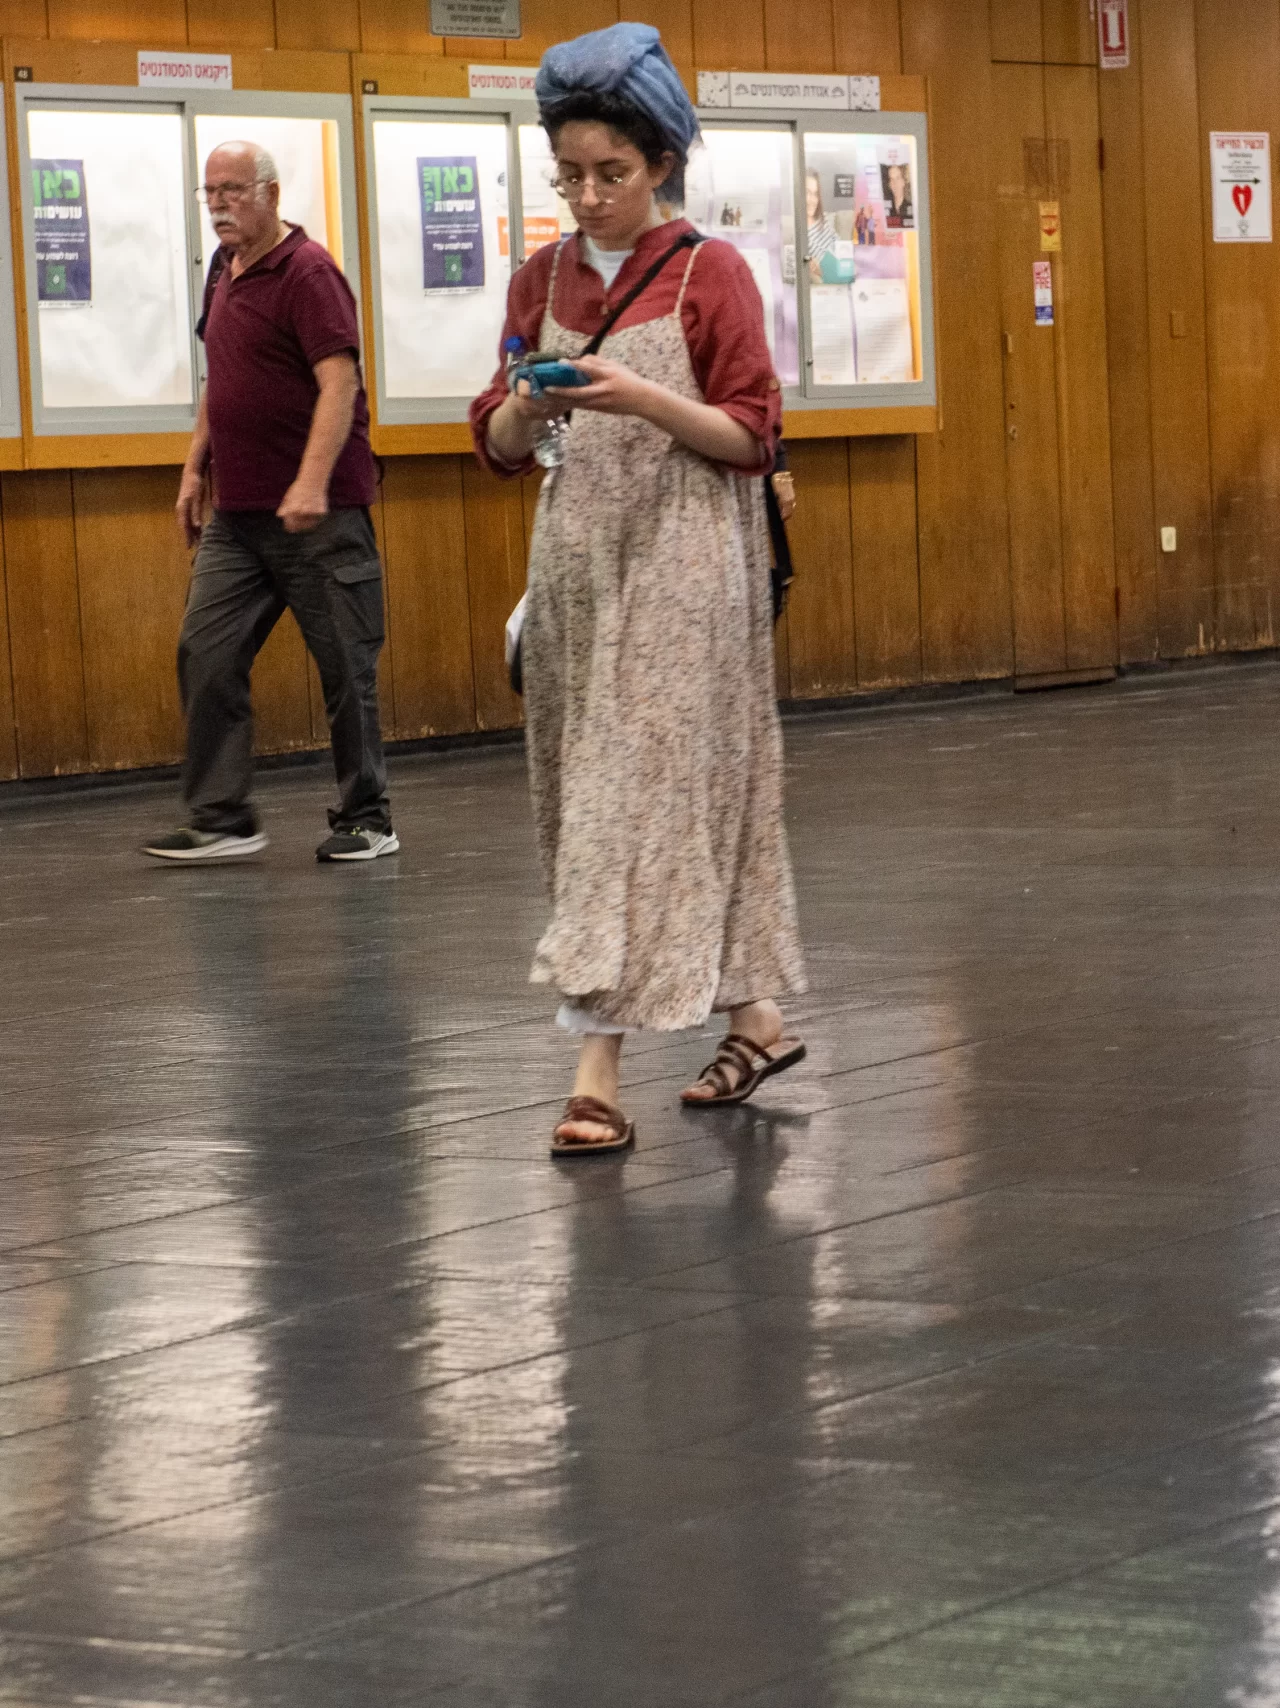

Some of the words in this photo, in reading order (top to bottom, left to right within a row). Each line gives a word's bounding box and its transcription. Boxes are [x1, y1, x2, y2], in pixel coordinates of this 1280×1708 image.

[140, 61, 193, 78] הסטודנטים
[195, 64, 229, 82] דיקנאט
[470, 74, 517, 90] הסטודנטים
[750, 83, 800, 97] הסטודנטים
[803, 84, 830, 98] אגודת
[32, 169, 81, 207] כאן
[433, 166, 474, 201] כאן
